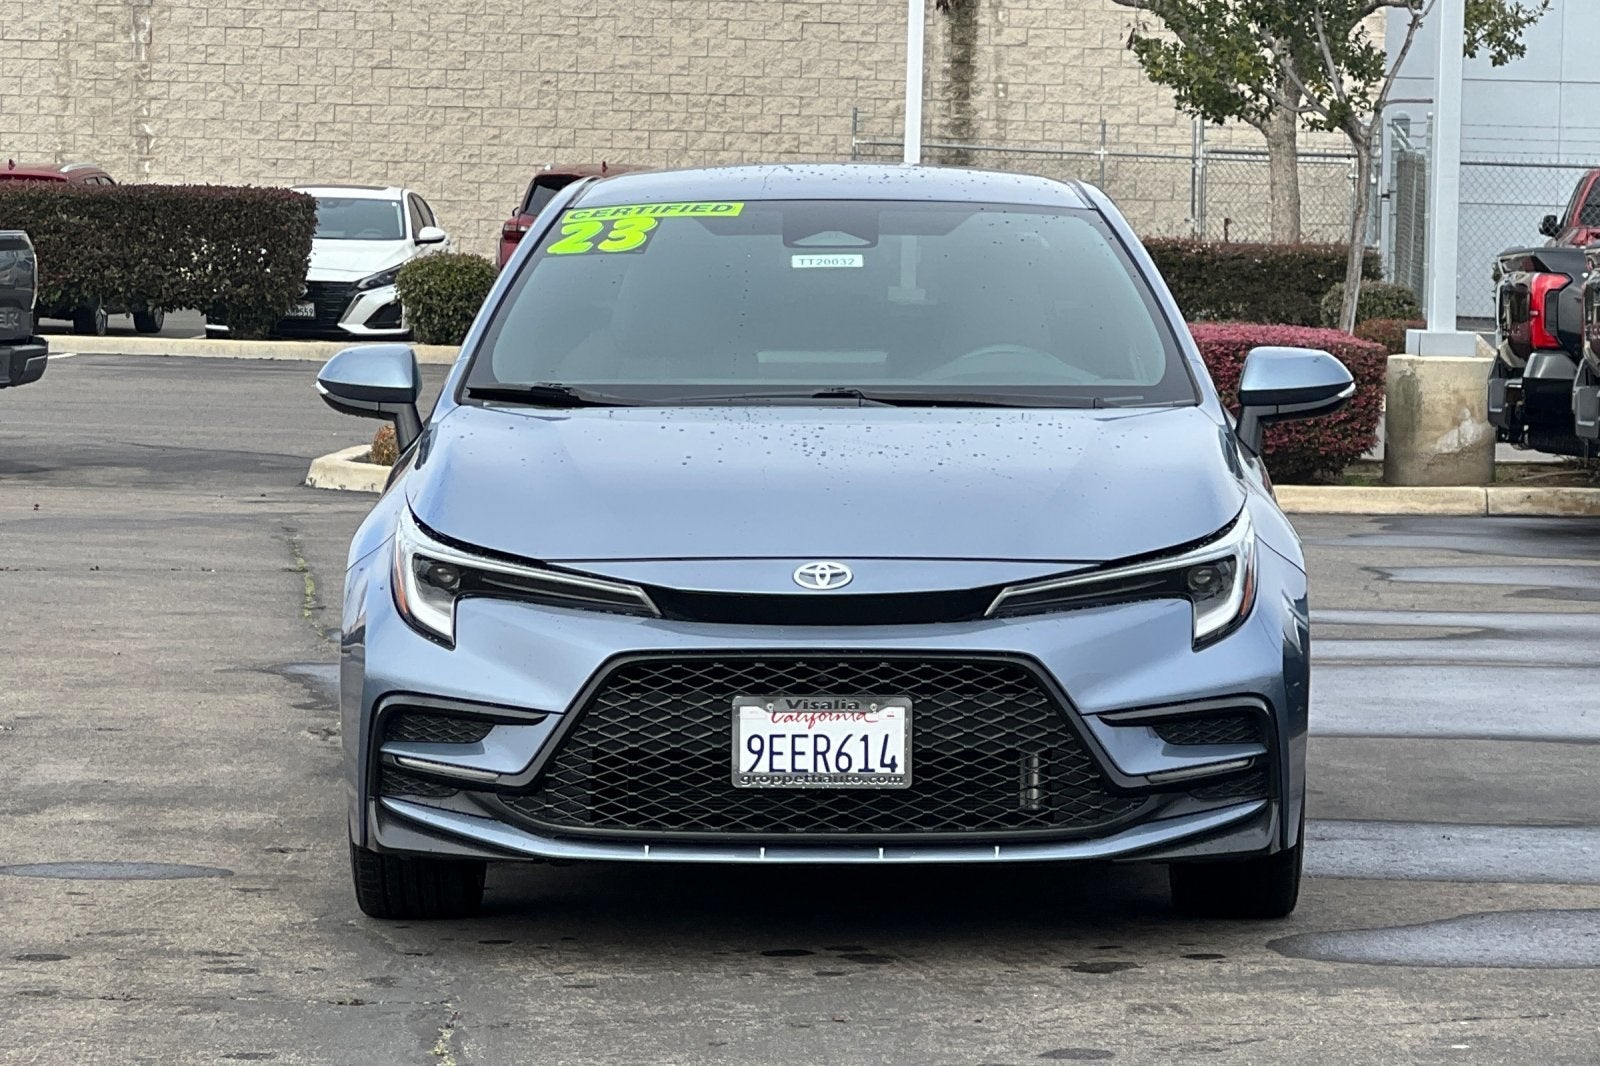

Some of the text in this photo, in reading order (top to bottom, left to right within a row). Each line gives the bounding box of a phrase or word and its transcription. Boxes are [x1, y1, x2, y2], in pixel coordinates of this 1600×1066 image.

[569, 203, 733, 219] CERTIFIED
[546, 216, 658, 254] 23
[785, 699, 860, 710] Visalia
[746, 733, 898, 773] 9EER614
